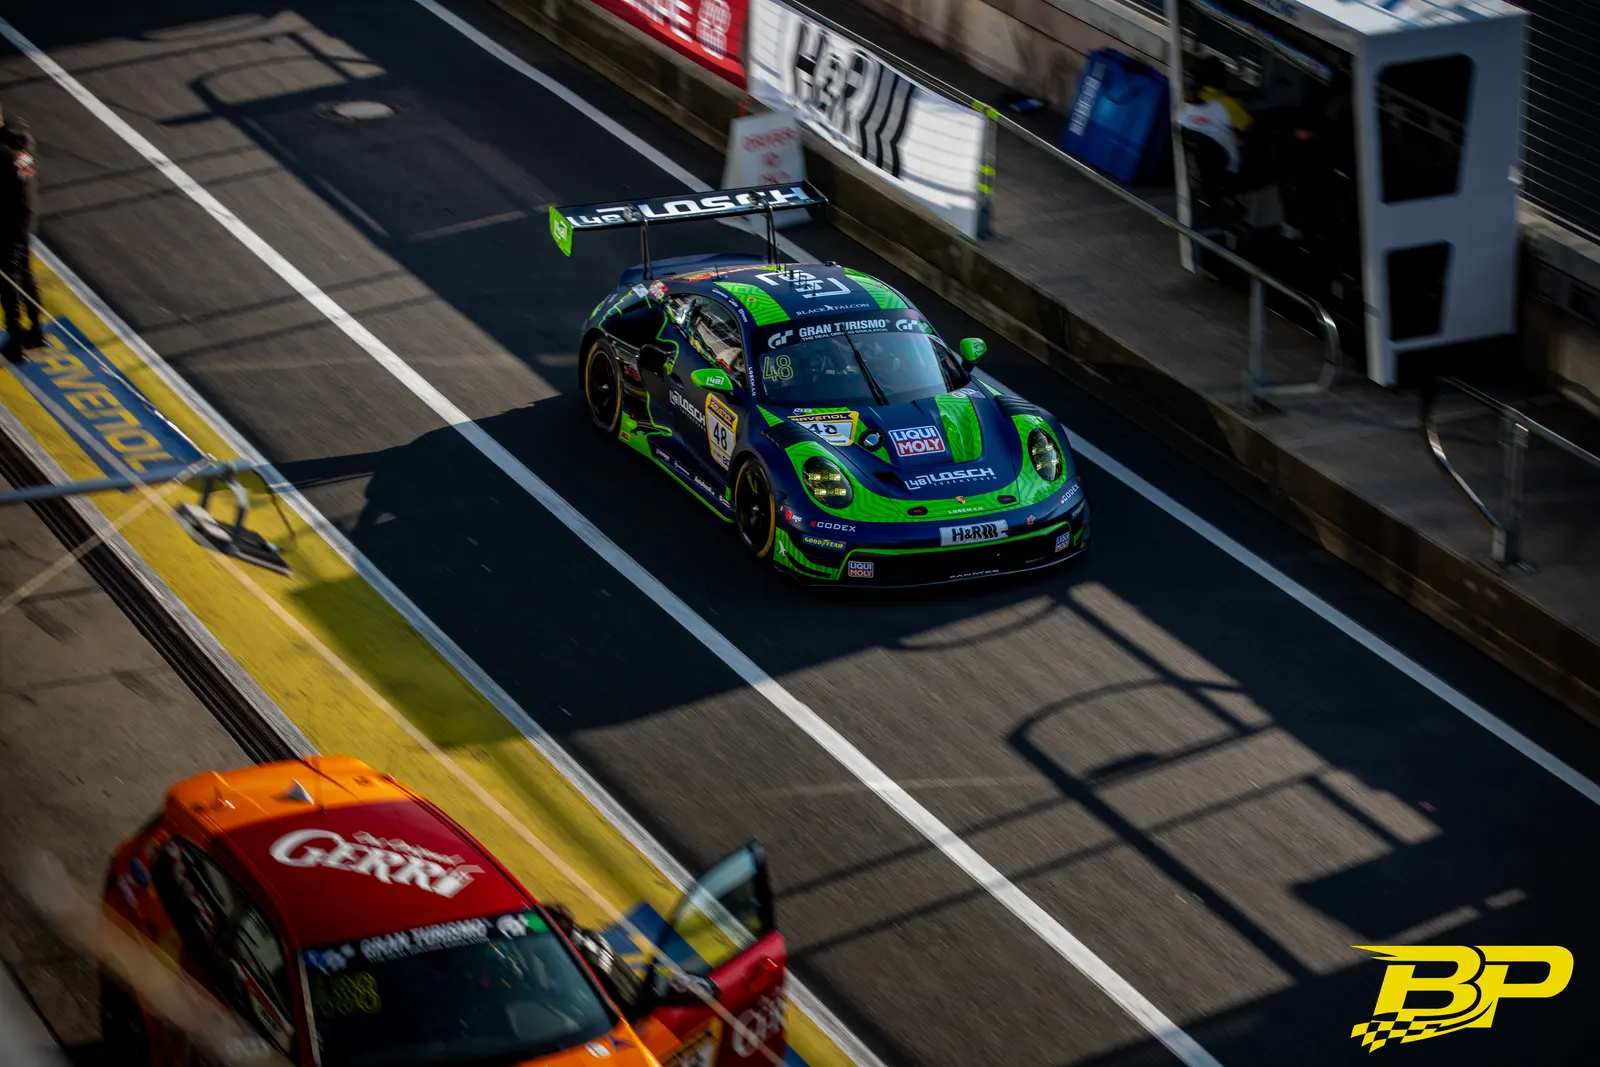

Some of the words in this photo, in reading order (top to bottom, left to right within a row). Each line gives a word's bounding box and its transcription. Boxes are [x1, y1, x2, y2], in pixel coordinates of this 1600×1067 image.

[637, 186, 814, 218] LOSCH
[795, 307, 826, 316] BLACK
[834, 303, 870, 311] FALCON
[798, 323, 832, 338] GRAN
[762, 354, 793, 382] 48
[713, 422, 728, 451] 48
[892, 427, 937, 443] LIQUI
[898, 440, 944, 455] MOLY
[929, 467, 995, 482] LOSCH
[816, 521, 857, 533] CODEX
[951, 524, 983, 542] H&R
[804, 537, 844, 549] GOODYEAR
[850, 562, 873, 570] LIQUI
[850, 569, 873, 577] MOLY
